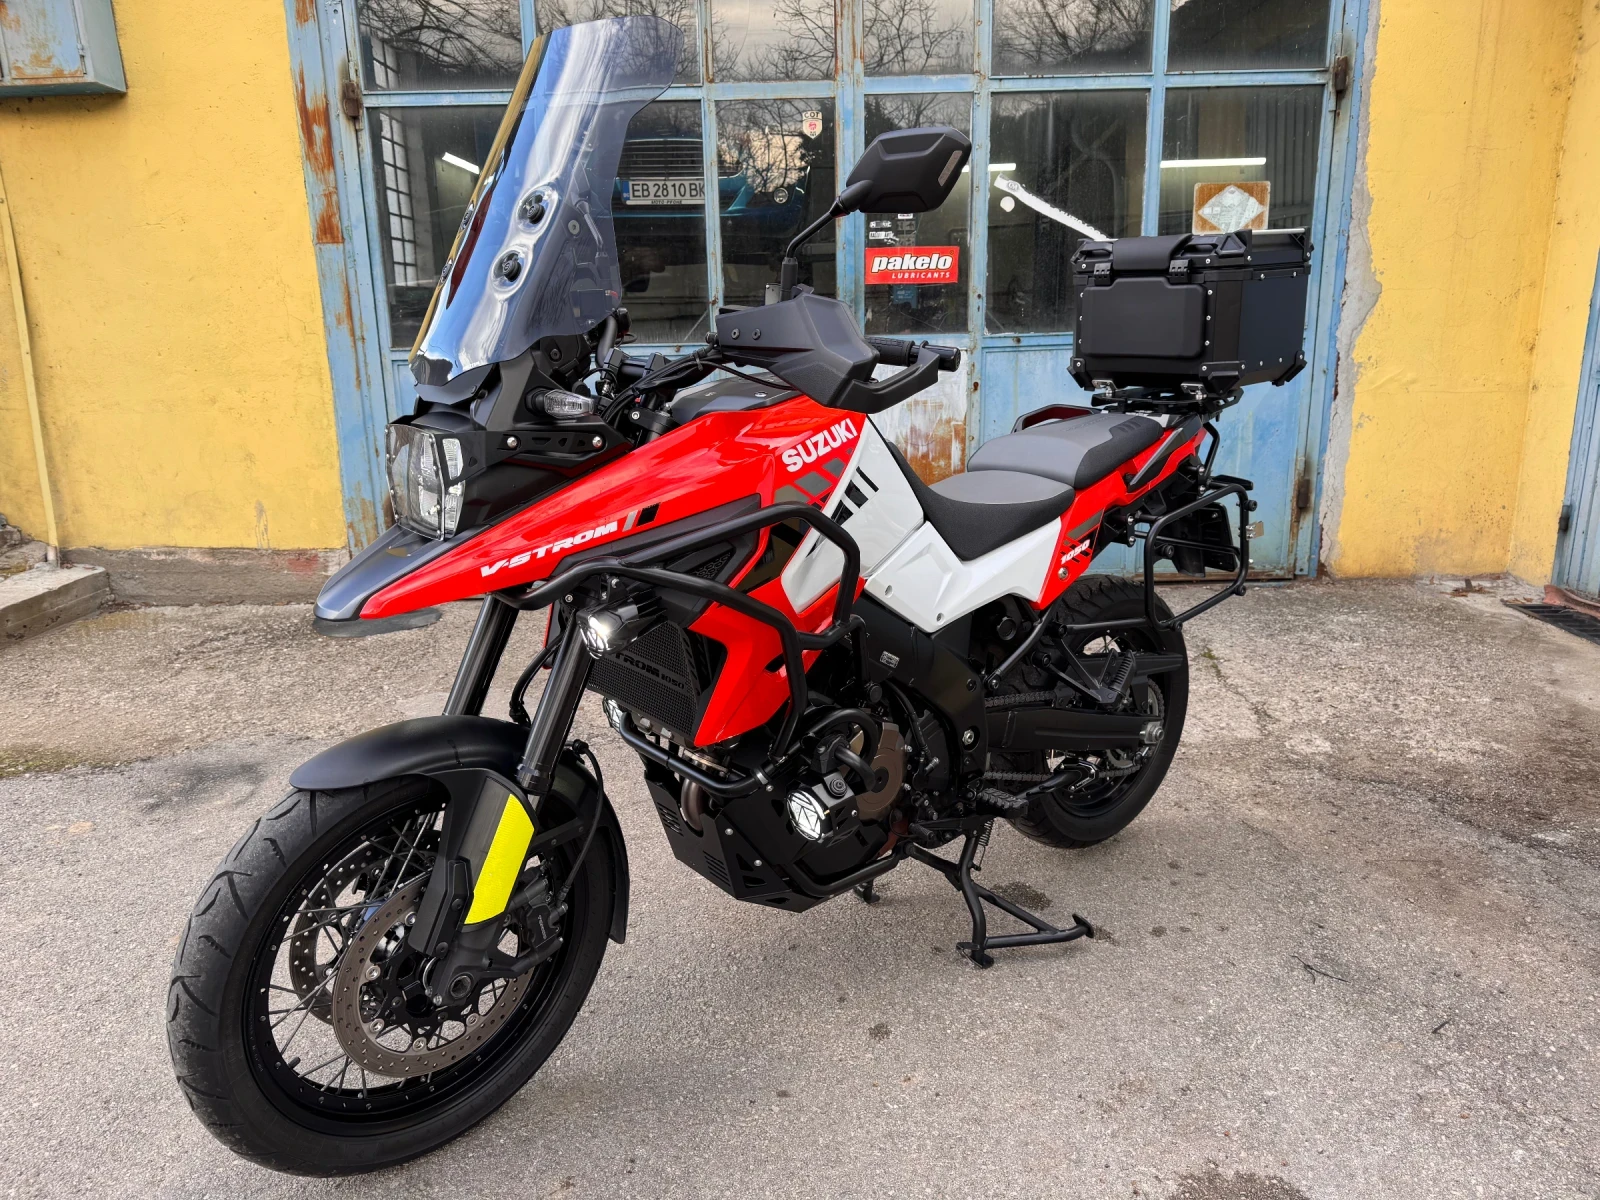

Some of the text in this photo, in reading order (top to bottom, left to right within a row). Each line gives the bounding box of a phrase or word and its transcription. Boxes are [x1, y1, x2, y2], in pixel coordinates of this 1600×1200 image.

[631, 183, 651, 198] EB
[652, 182, 687, 198] 2810
[871, 253, 953, 273] pakelo
[781, 418, 858, 473] SUZUKI
[480, 521, 618, 578] V-STROM
[1061, 539, 1090, 565] 1050
[615, 651, 661, 678] TROM
